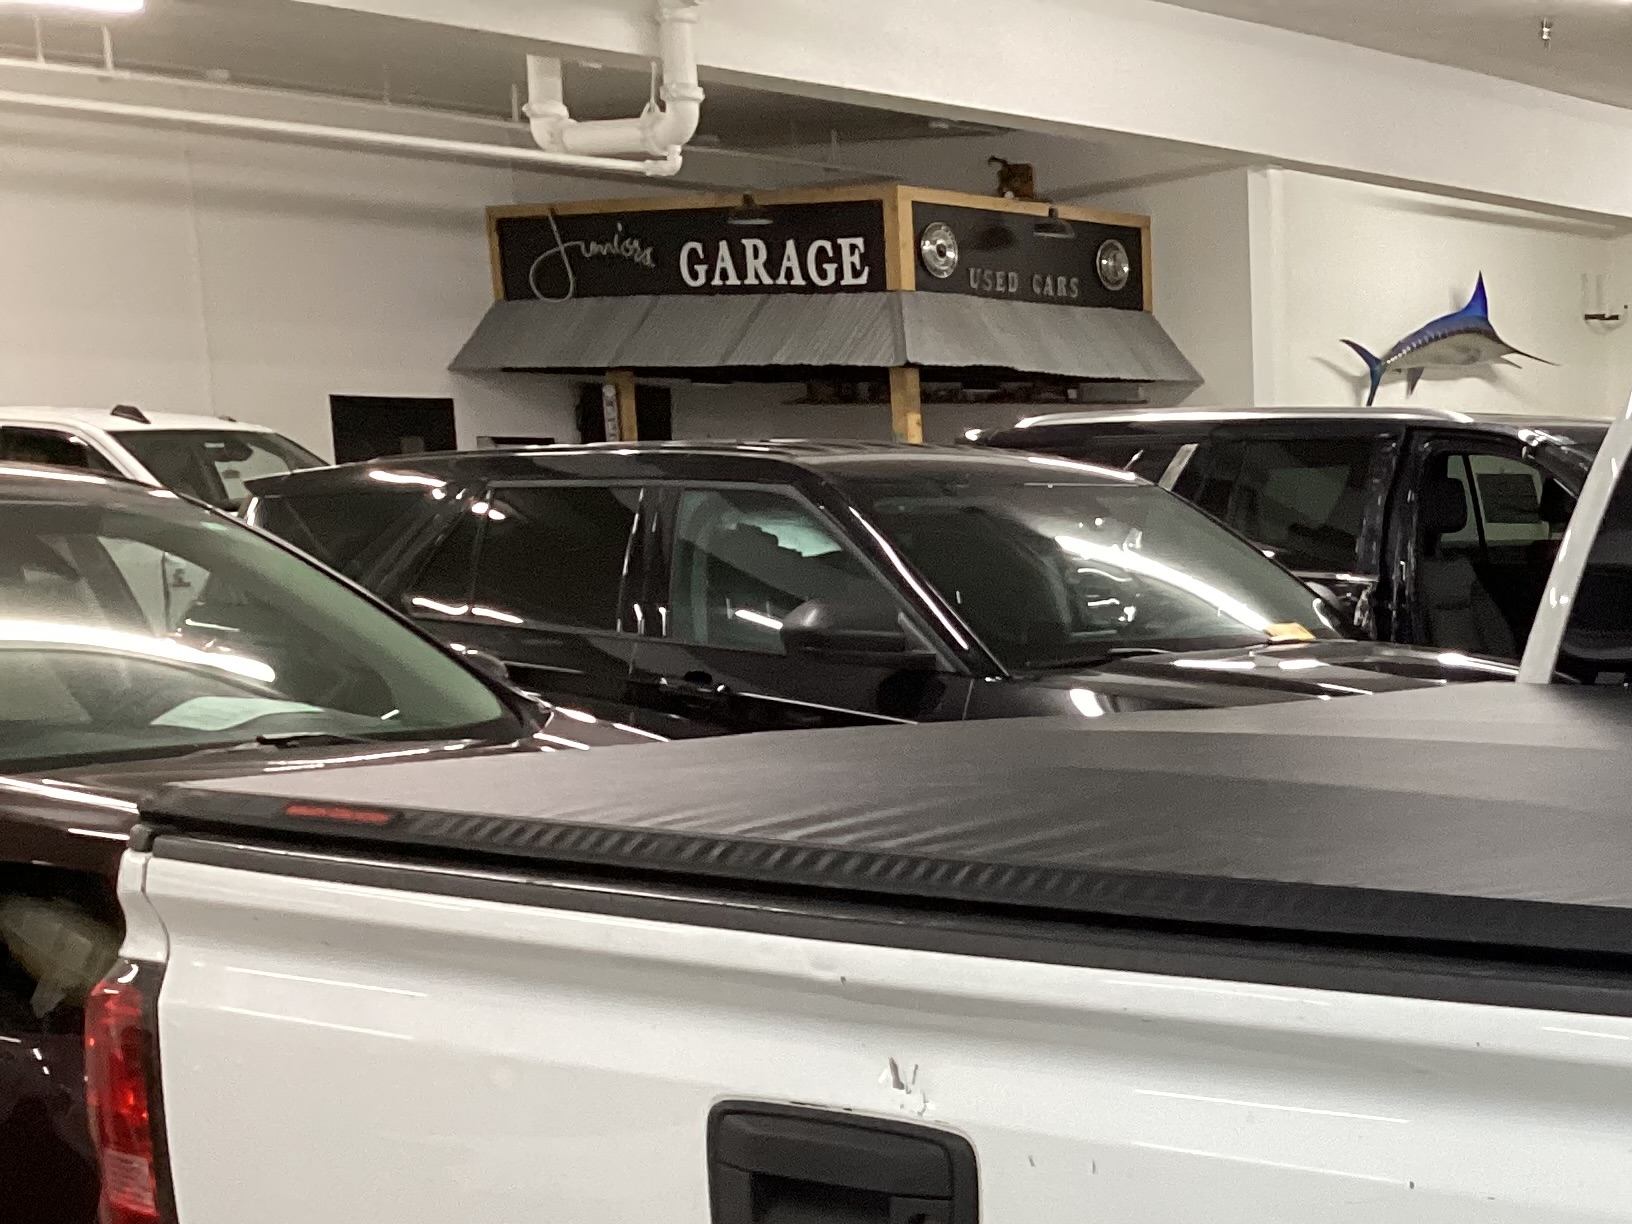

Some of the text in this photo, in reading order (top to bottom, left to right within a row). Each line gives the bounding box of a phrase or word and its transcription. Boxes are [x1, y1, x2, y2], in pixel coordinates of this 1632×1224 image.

[679, 236, 870, 288] GARAGE
[968, 267, 1080, 299] USED CARS
